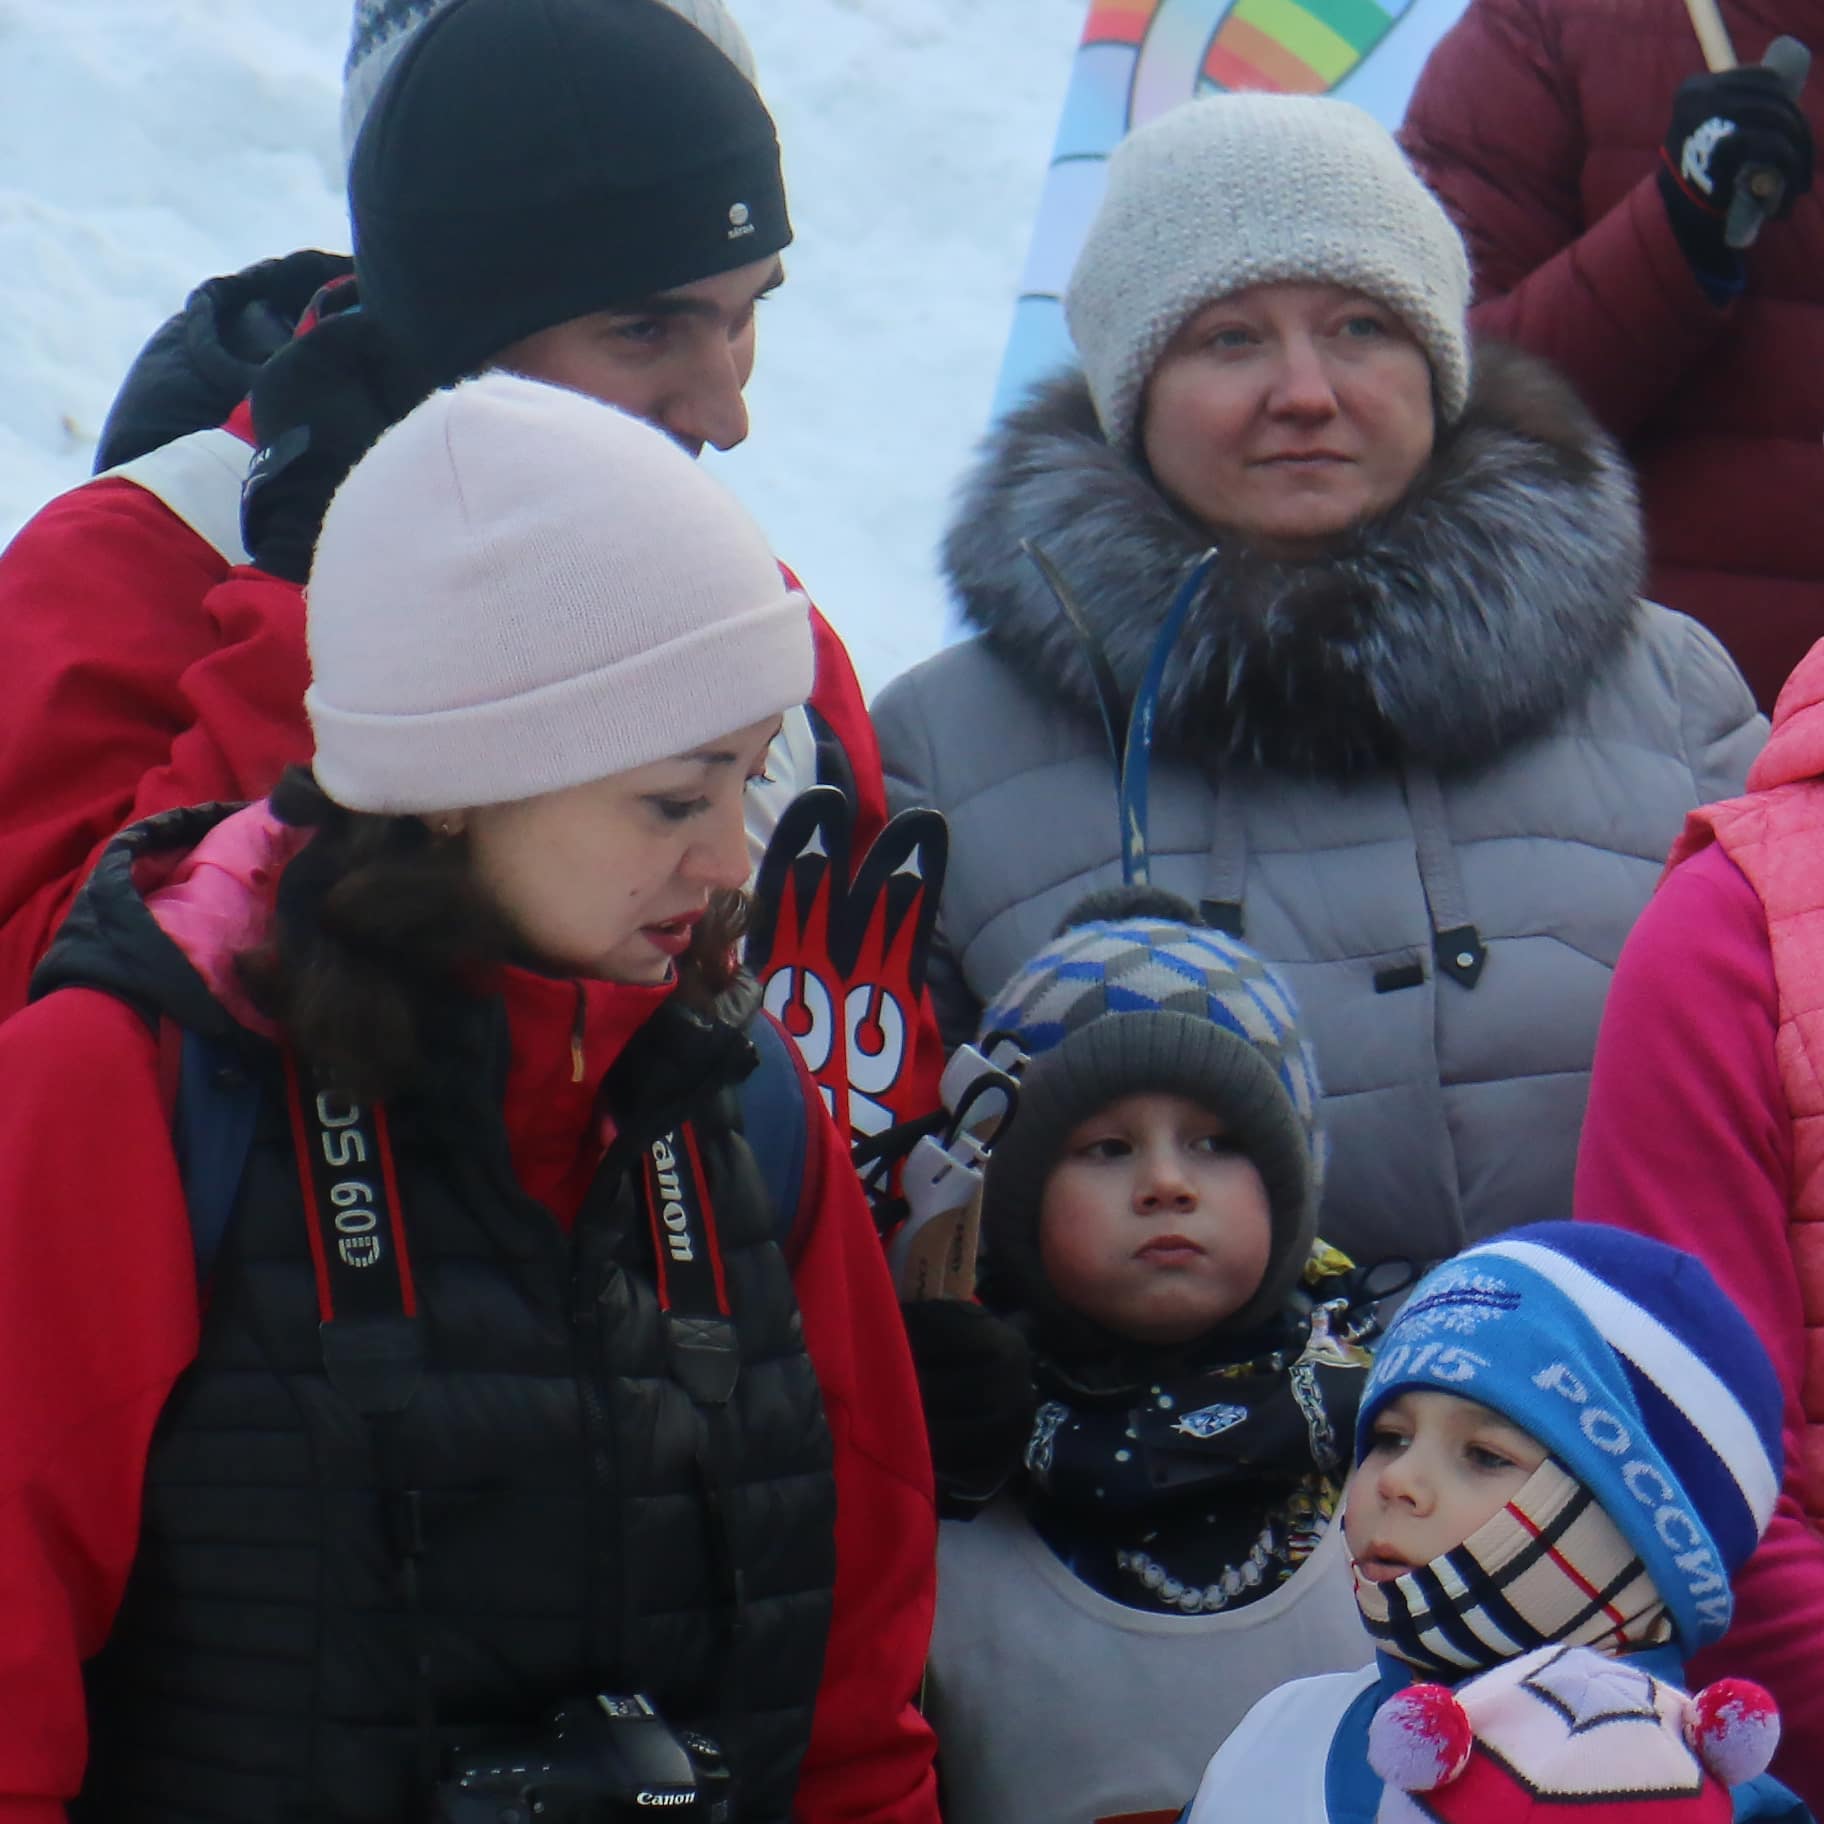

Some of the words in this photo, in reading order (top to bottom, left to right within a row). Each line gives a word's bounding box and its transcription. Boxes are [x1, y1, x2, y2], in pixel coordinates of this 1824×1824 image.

[330, 1181, 381, 1268] 60D
[652, 1131, 694, 1262] anon
[636, 1791, 696, 1806] Canon
